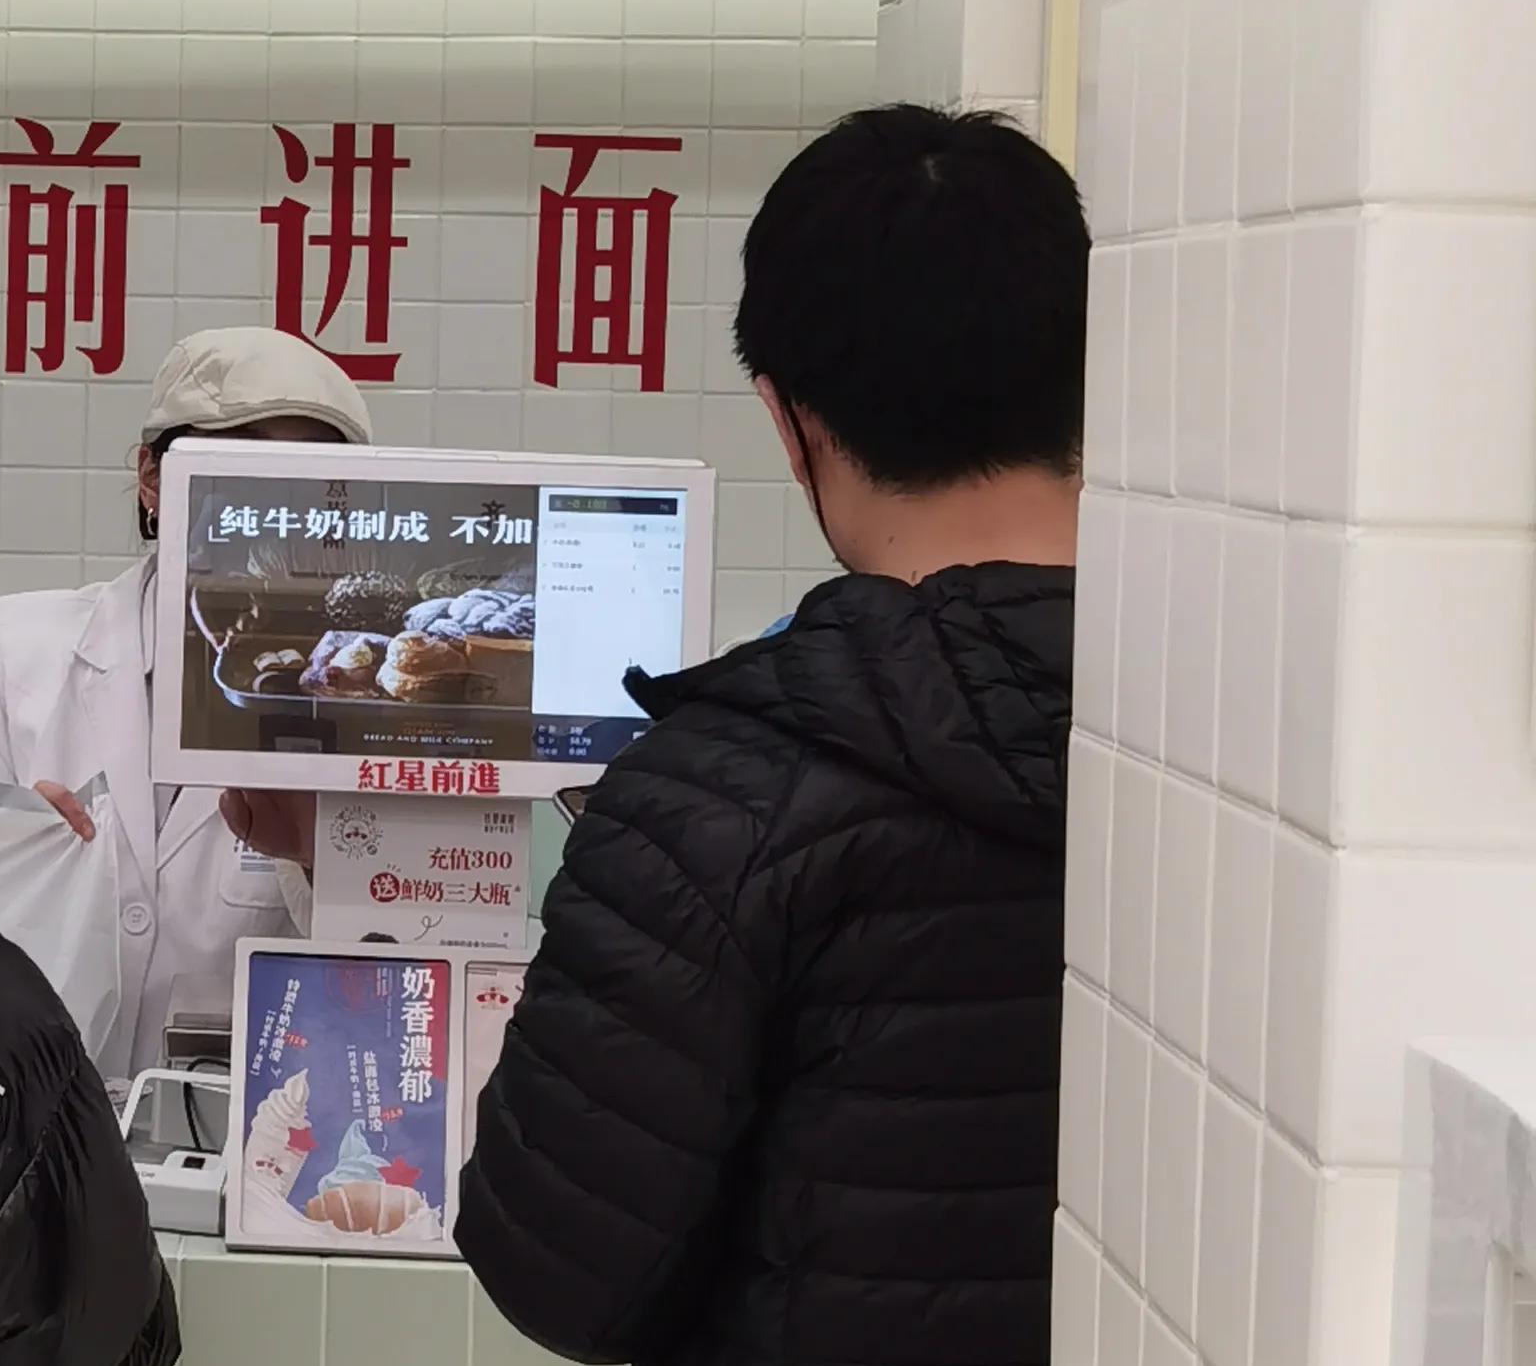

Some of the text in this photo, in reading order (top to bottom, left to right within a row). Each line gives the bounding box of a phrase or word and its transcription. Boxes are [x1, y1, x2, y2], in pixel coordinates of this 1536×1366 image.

[219, 505, 534, 545] 纯牛奶制成 不加
[358, 759, 501, 795] 紅星前進
[428, 846, 513, 870] 充值300
[398, 966, 436, 1103] 奶香濃郁
